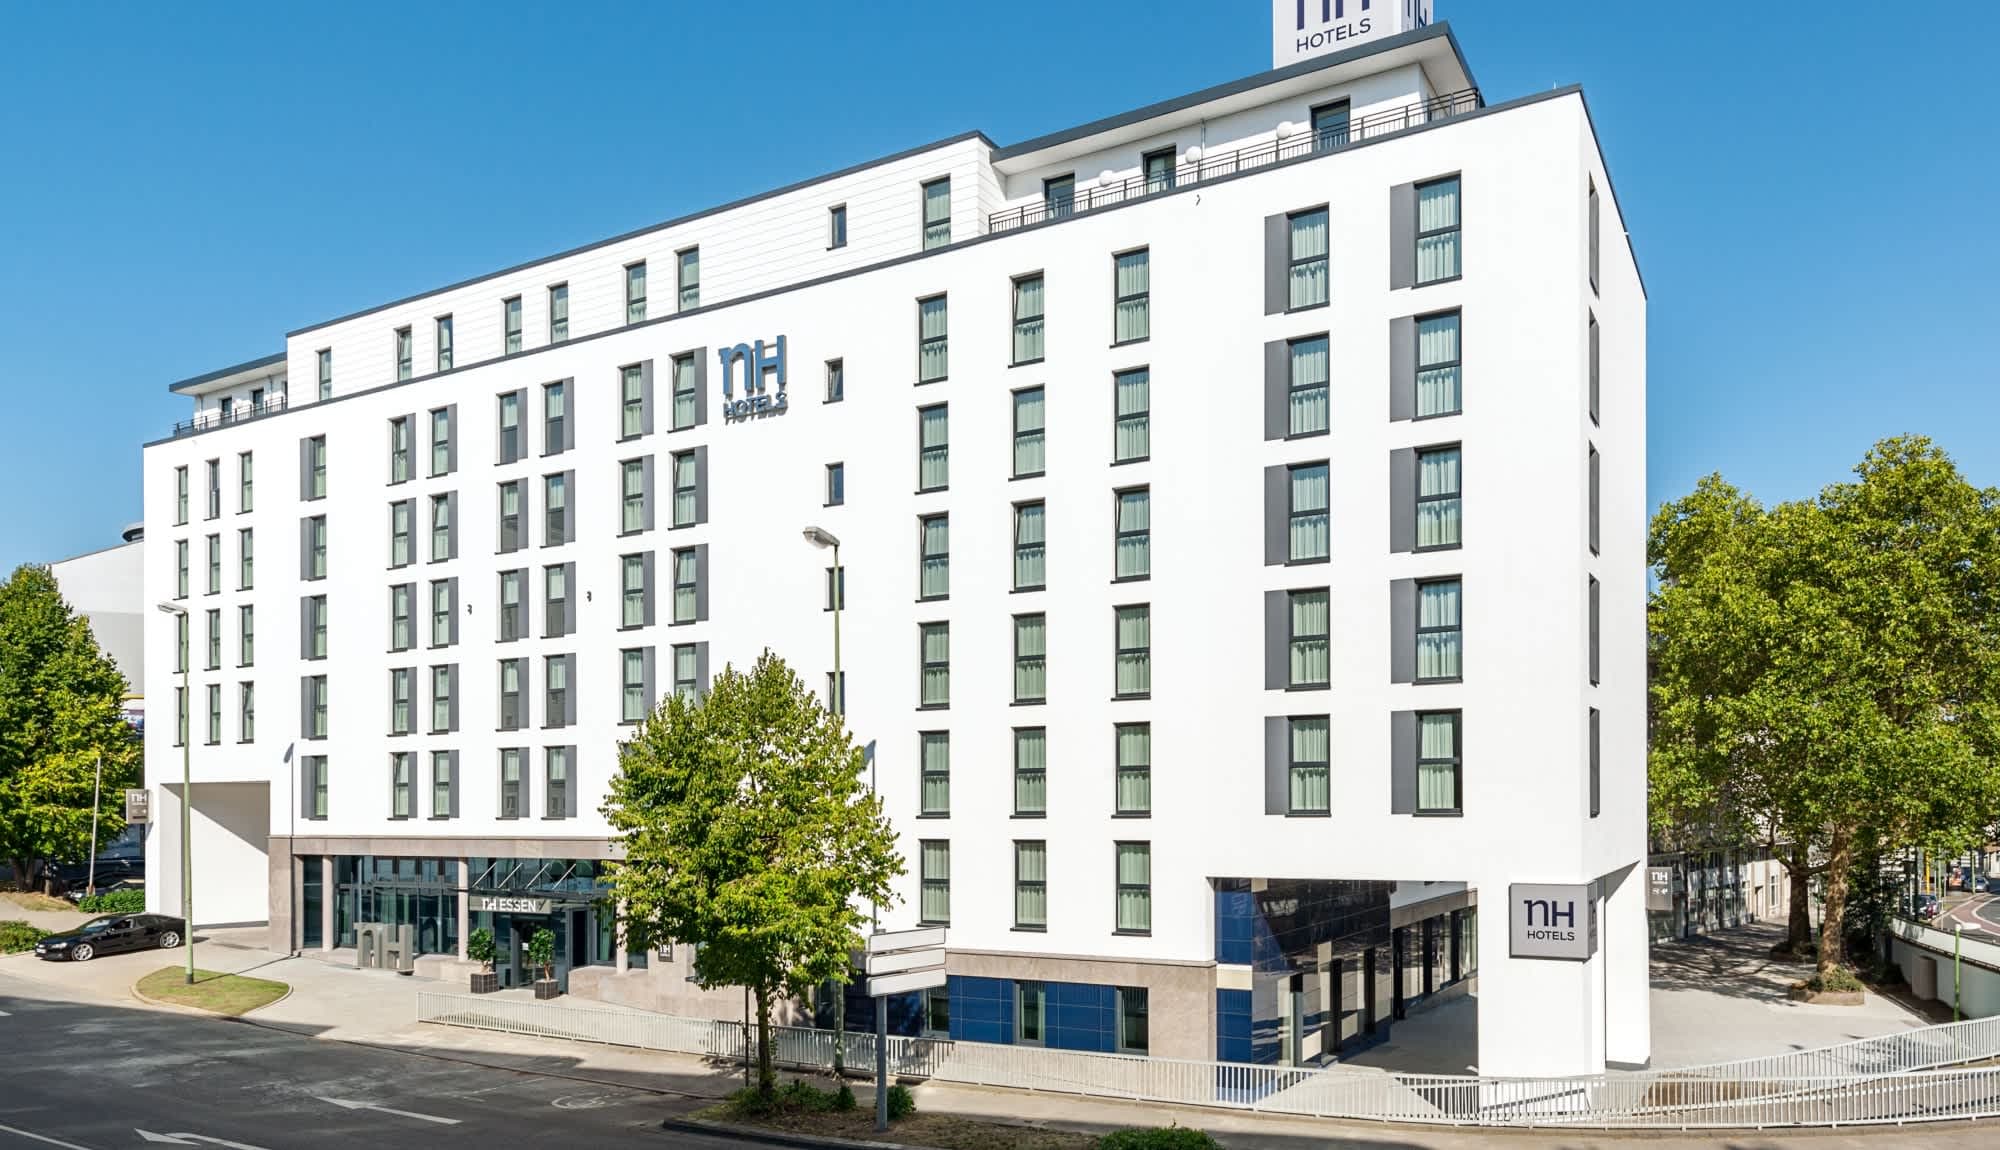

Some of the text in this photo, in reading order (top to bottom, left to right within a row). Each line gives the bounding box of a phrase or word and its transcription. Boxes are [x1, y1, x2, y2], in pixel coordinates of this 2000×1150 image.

[1296, 18, 1371, 52] HOTELS
[723, 392, 788, 422] HOTELS
[499, 898, 536, 912] ESSEN
[1527, 930, 1575, 942] HOTELS
